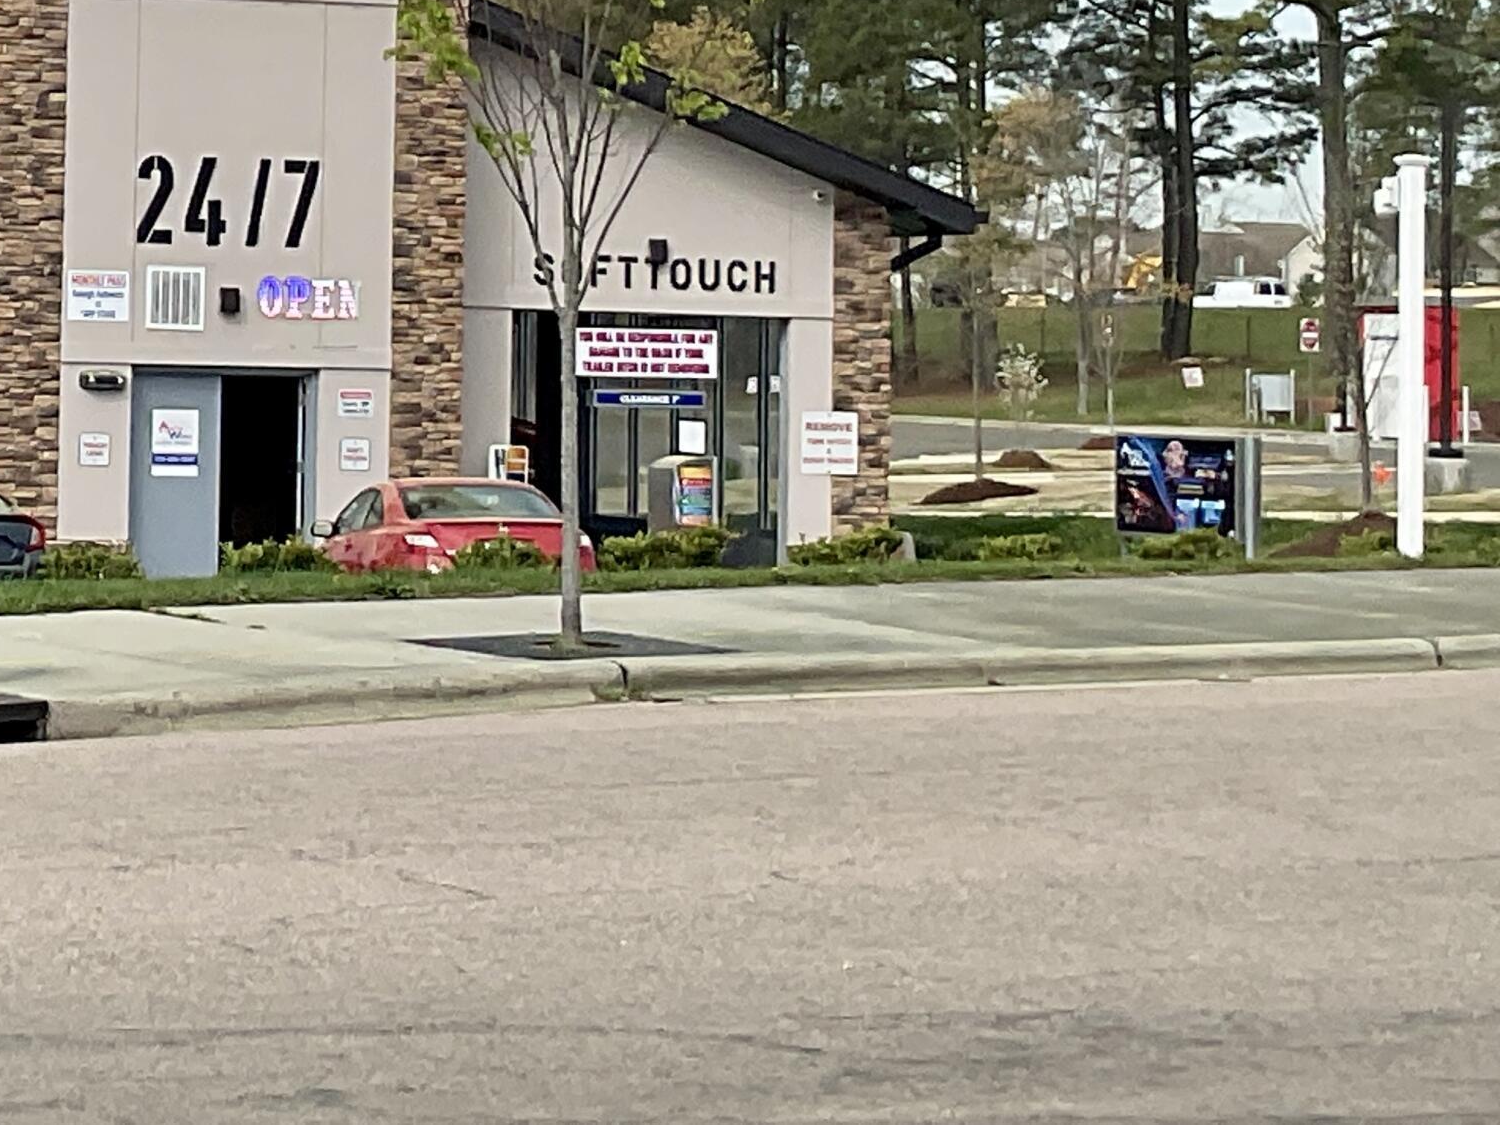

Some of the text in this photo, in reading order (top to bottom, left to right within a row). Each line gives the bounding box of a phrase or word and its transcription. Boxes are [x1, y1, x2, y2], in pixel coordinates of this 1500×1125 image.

[136, 155, 320, 248] 24/7
[534, 253, 776, 294] SFTTOUCH
[257, 275, 361, 319] OPEN
